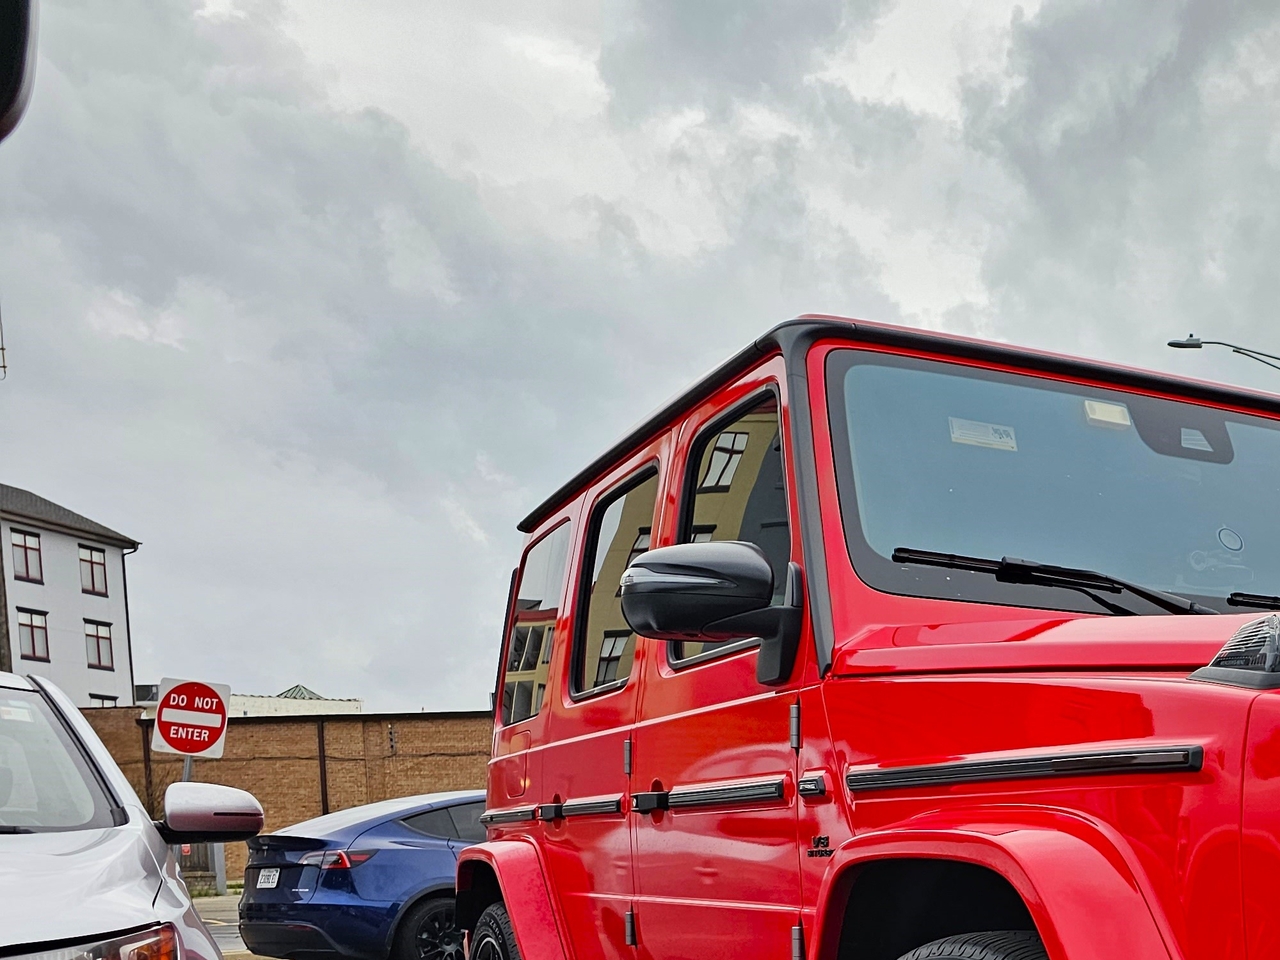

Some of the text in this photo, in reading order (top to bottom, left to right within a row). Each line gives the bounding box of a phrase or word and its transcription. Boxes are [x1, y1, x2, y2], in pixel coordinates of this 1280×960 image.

[170, 693, 219, 710] DO NOT
[170, 726, 209, 742] ENTER
